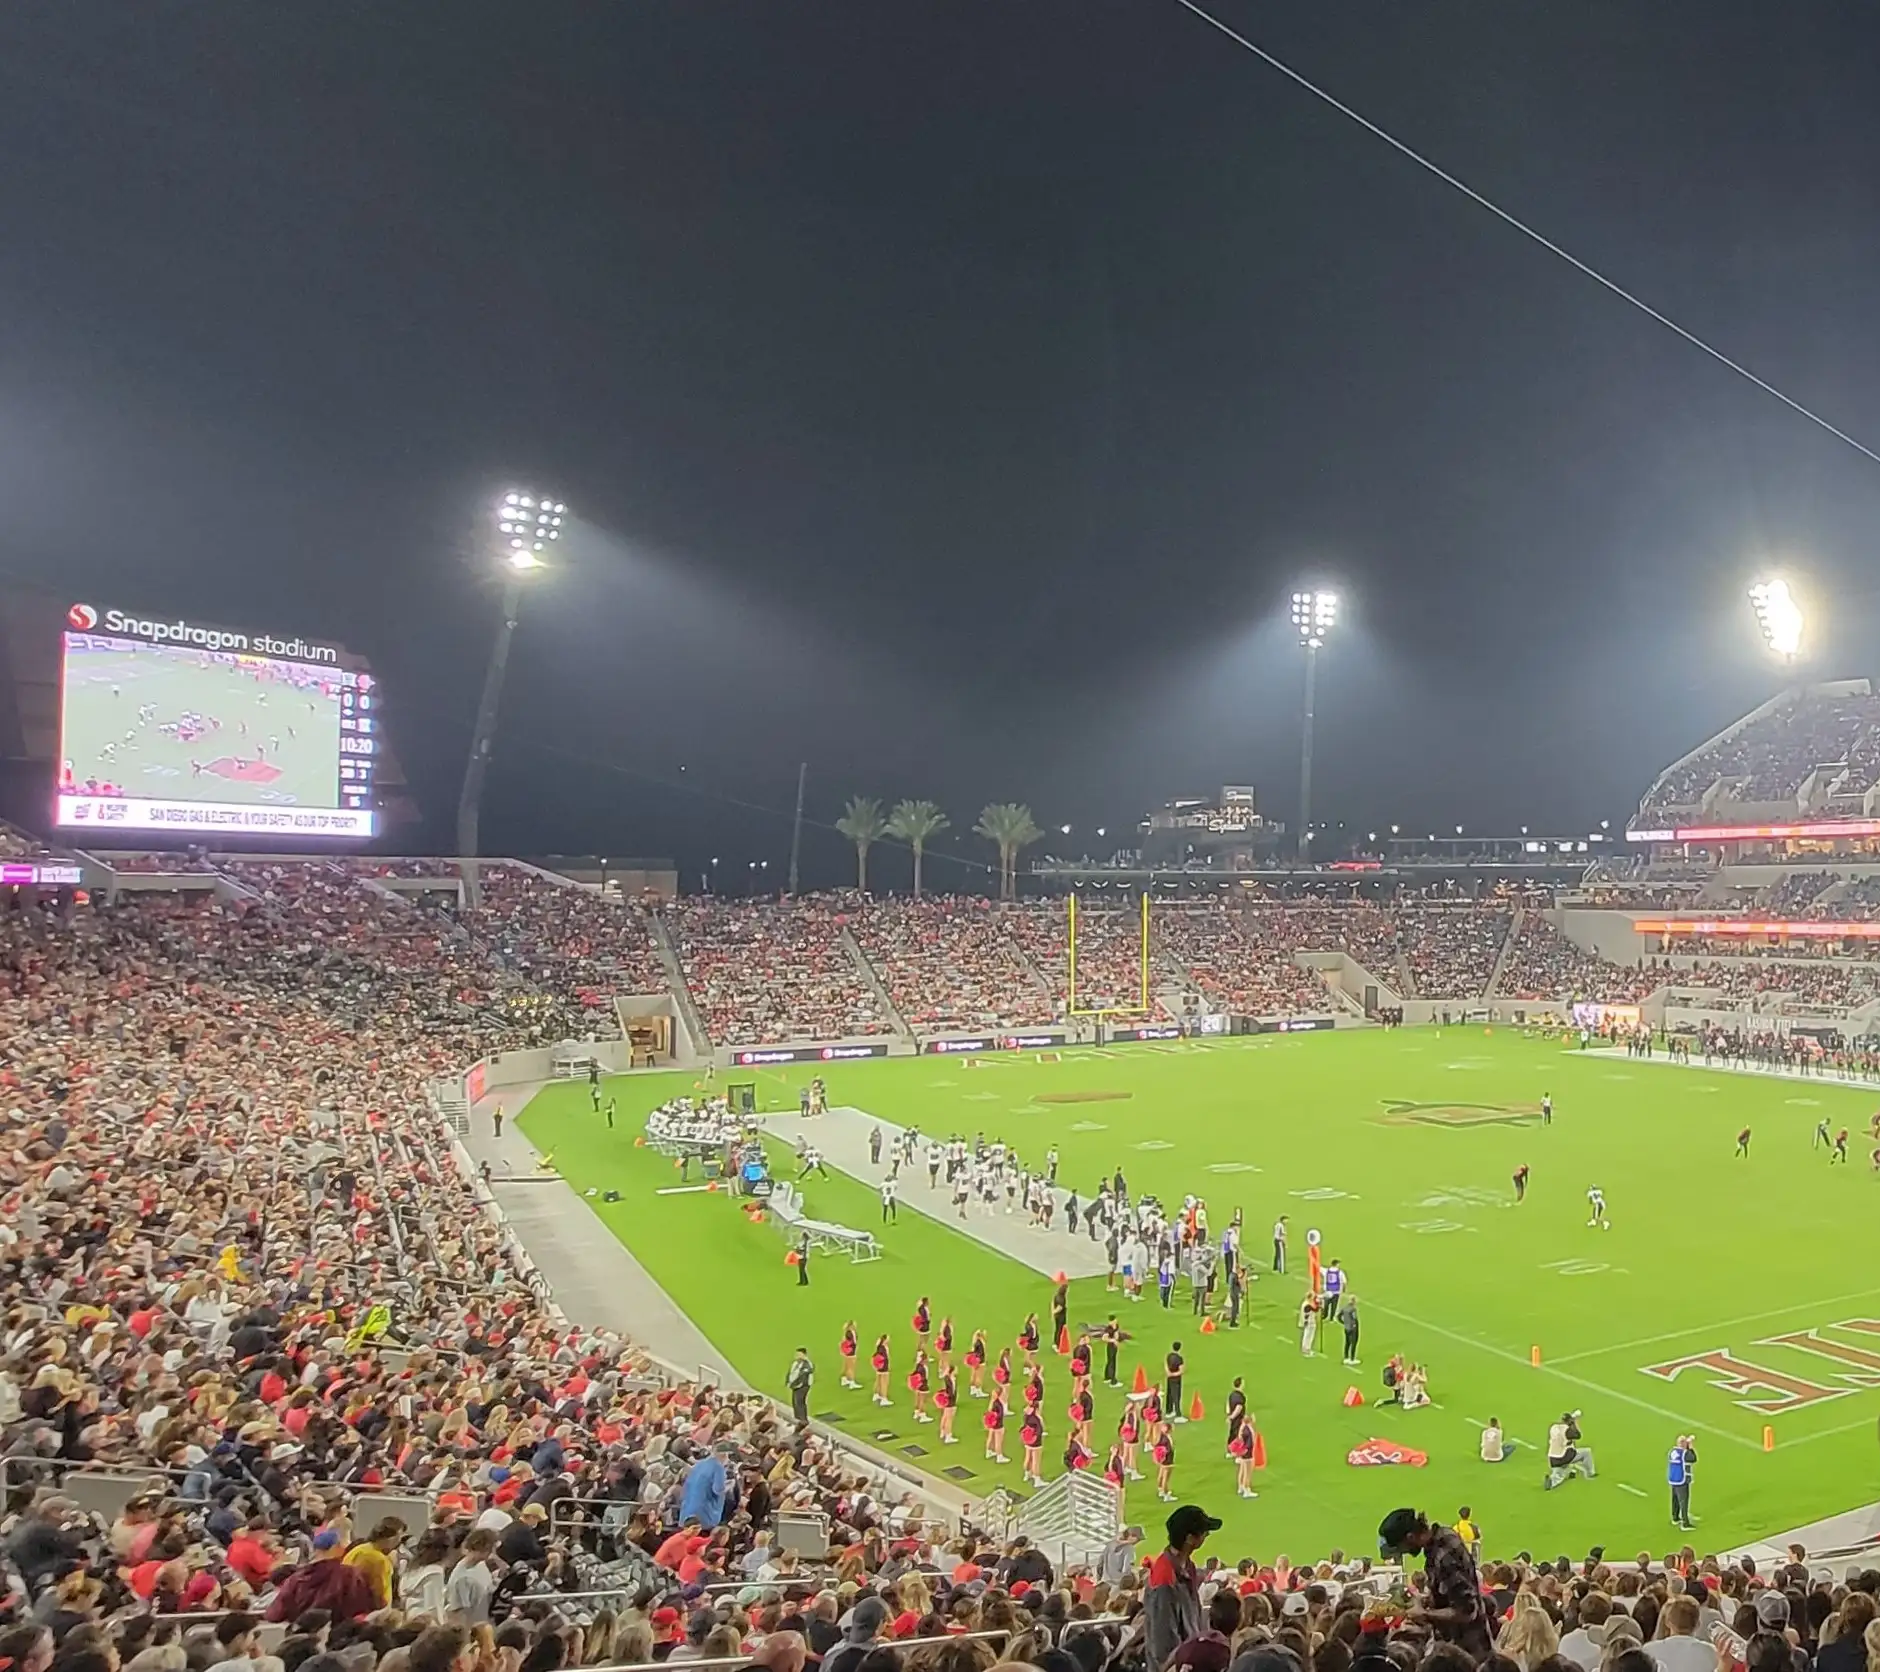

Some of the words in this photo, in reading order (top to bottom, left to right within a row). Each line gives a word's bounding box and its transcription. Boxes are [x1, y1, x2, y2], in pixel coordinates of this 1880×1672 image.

[104, 609, 248, 650] Snapdragon
[252, 634, 338, 663] stadium
[340, 737, 373, 754] 10:20
